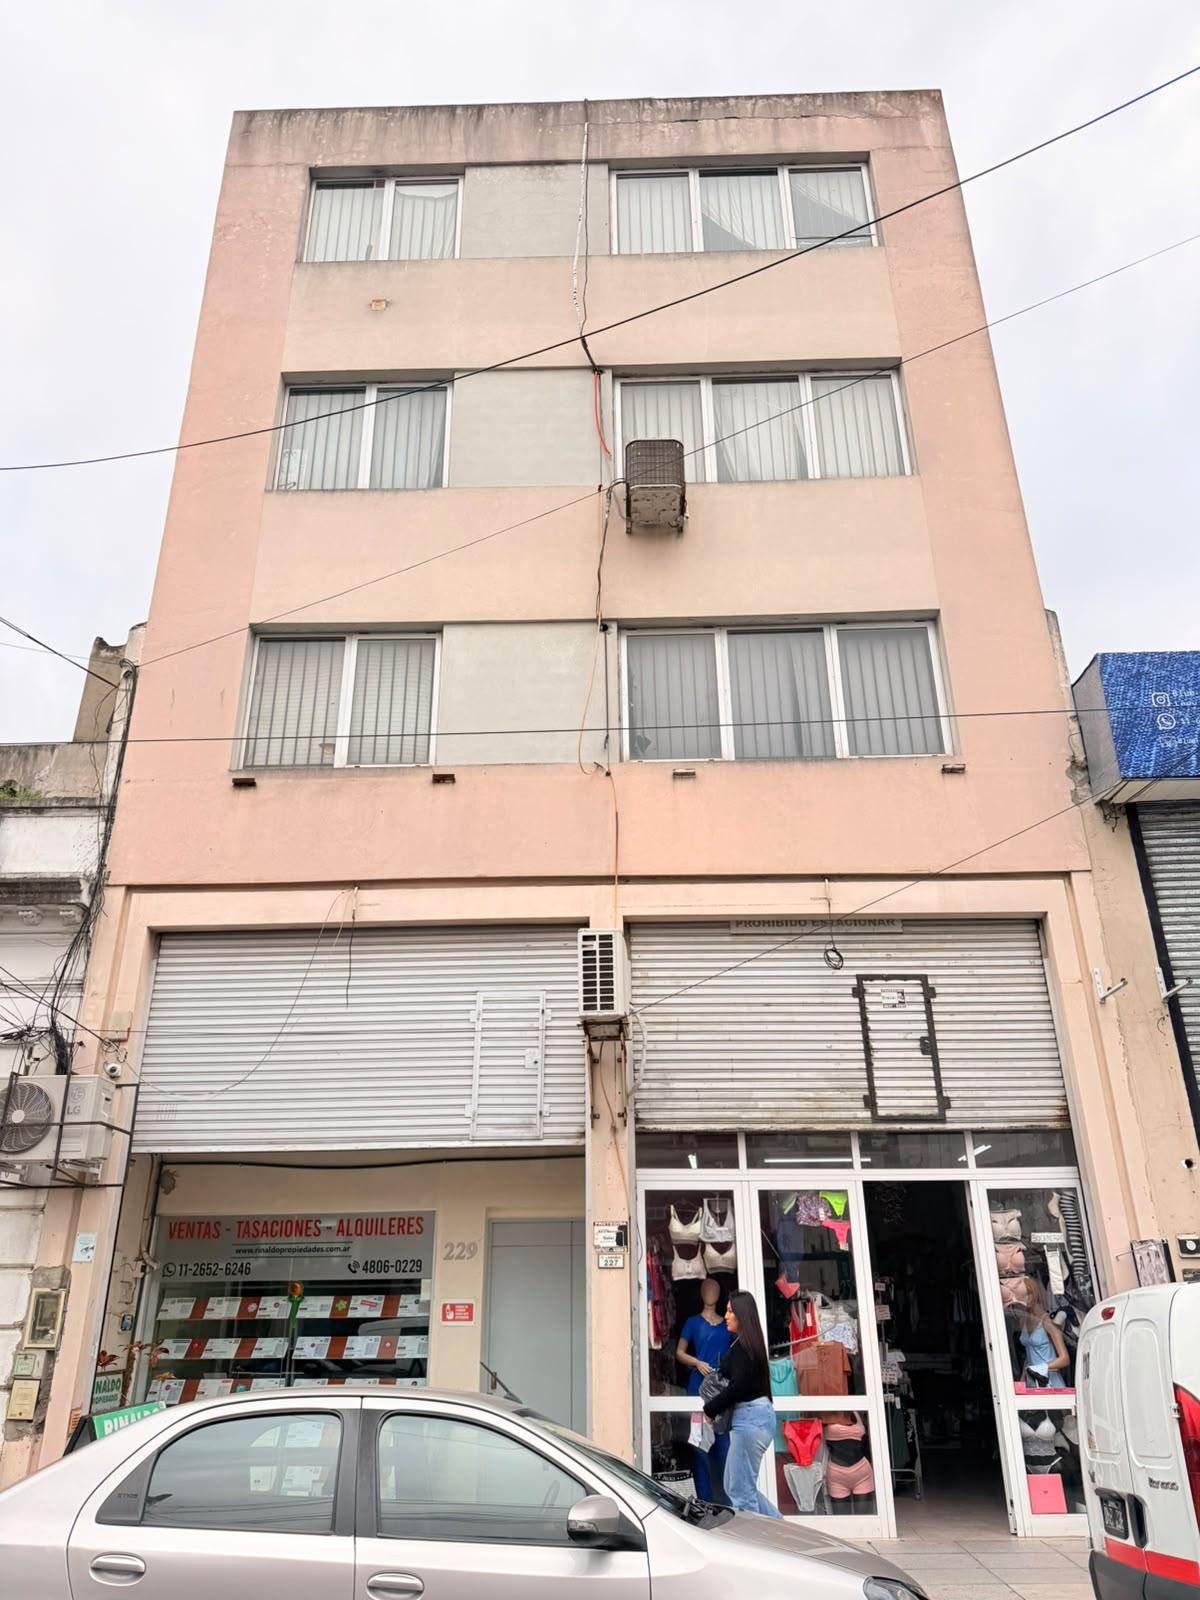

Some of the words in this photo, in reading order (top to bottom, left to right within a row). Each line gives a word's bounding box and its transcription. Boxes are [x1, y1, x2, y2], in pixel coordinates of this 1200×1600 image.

[735, 919, 807, 928] PROHIBIDO
[66, 1105, 81, 1115] LG
[168, 1221, 221, 1239] VENTAS
[236, 1219, 321, 1239] TASACIONES
[336, 1216, 424, 1237] ALQUILERES
[443, 1242, 478, 1261] 229
[178, 1262, 251, 1277] 11-2652-6246
[362, 1259, 422, 1274] 4806-0229
